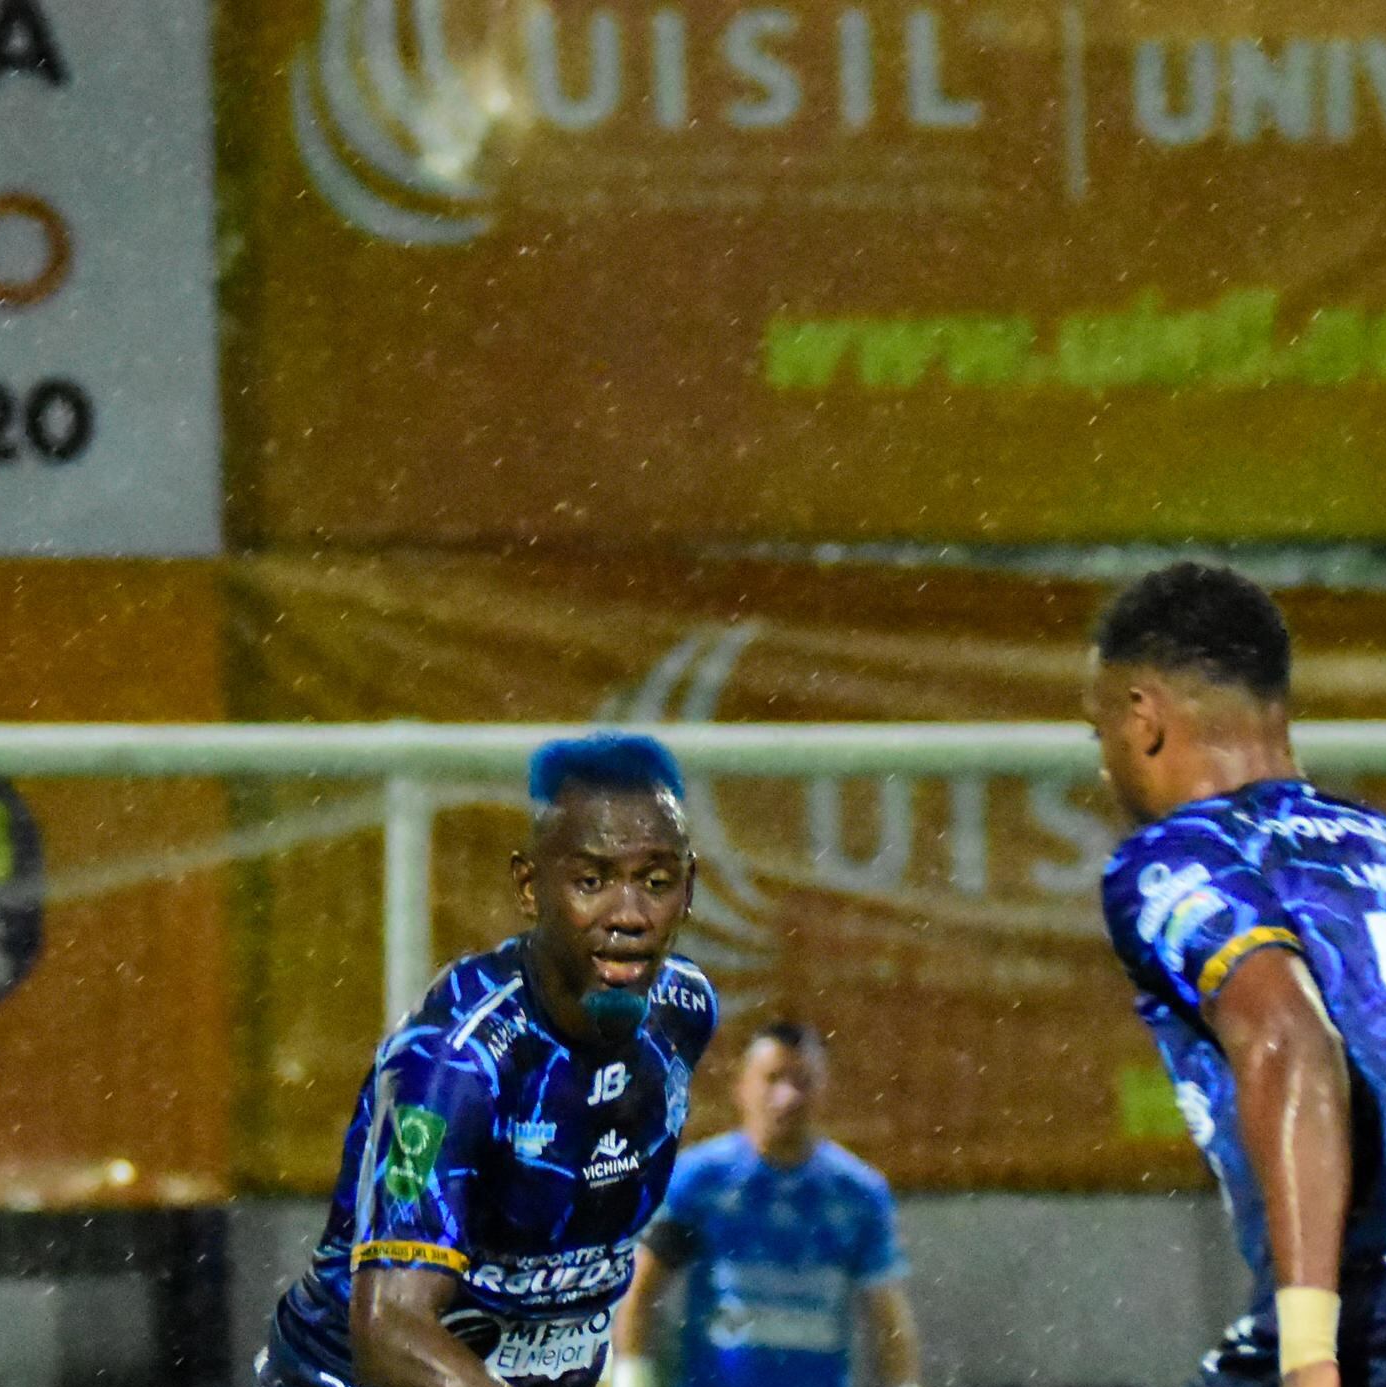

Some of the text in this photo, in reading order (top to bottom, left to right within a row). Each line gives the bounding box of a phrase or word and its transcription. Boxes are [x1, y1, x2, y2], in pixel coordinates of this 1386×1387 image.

[525, 8, 984, 132] UISIL
[587, 1061, 631, 1106] JB
[582, 1150, 639, 1181] VICHIMA
